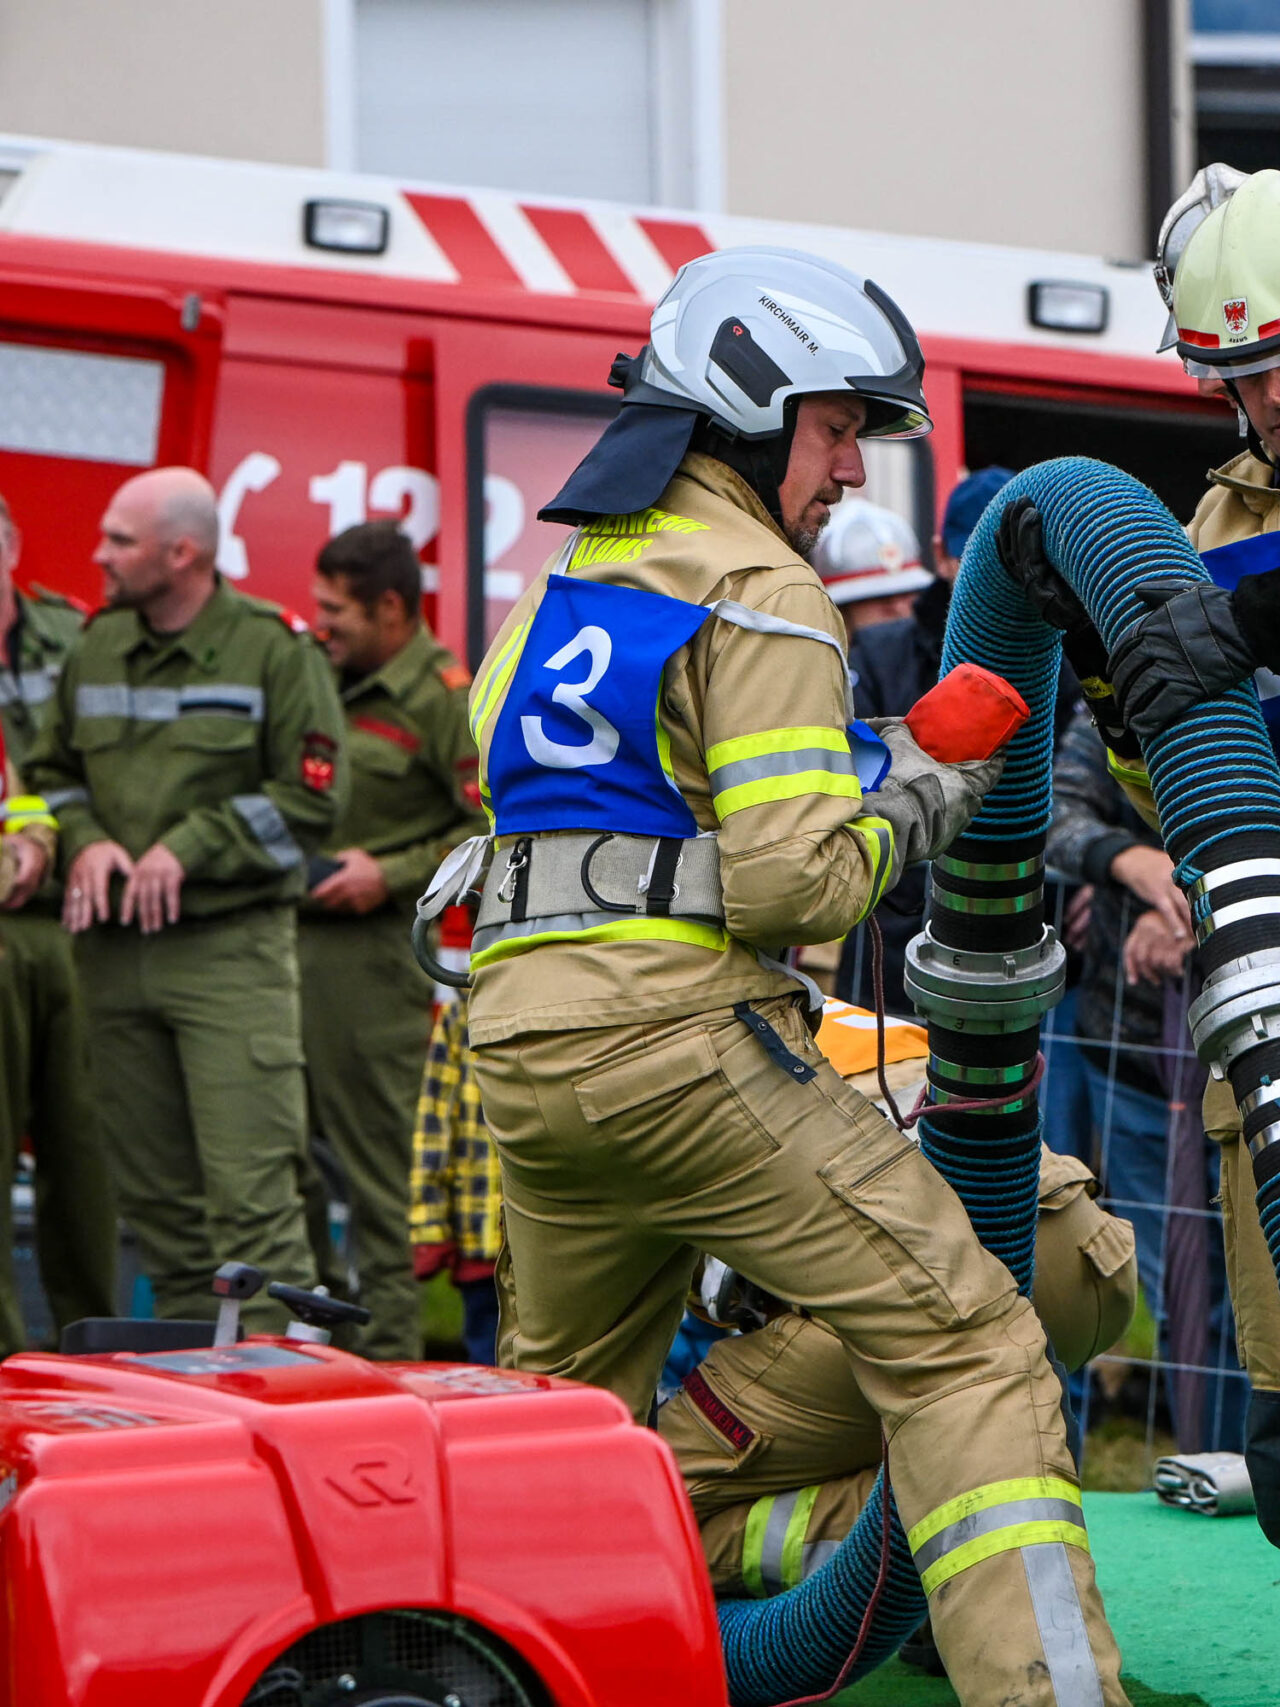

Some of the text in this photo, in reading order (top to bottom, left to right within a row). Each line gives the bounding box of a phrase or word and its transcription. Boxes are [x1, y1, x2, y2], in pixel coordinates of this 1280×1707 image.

[758, 295, 819, 356] KIRCHMAIR M.
[567, 537, 654, 571] AXAMS
[520, 625, 620, 768] 3
